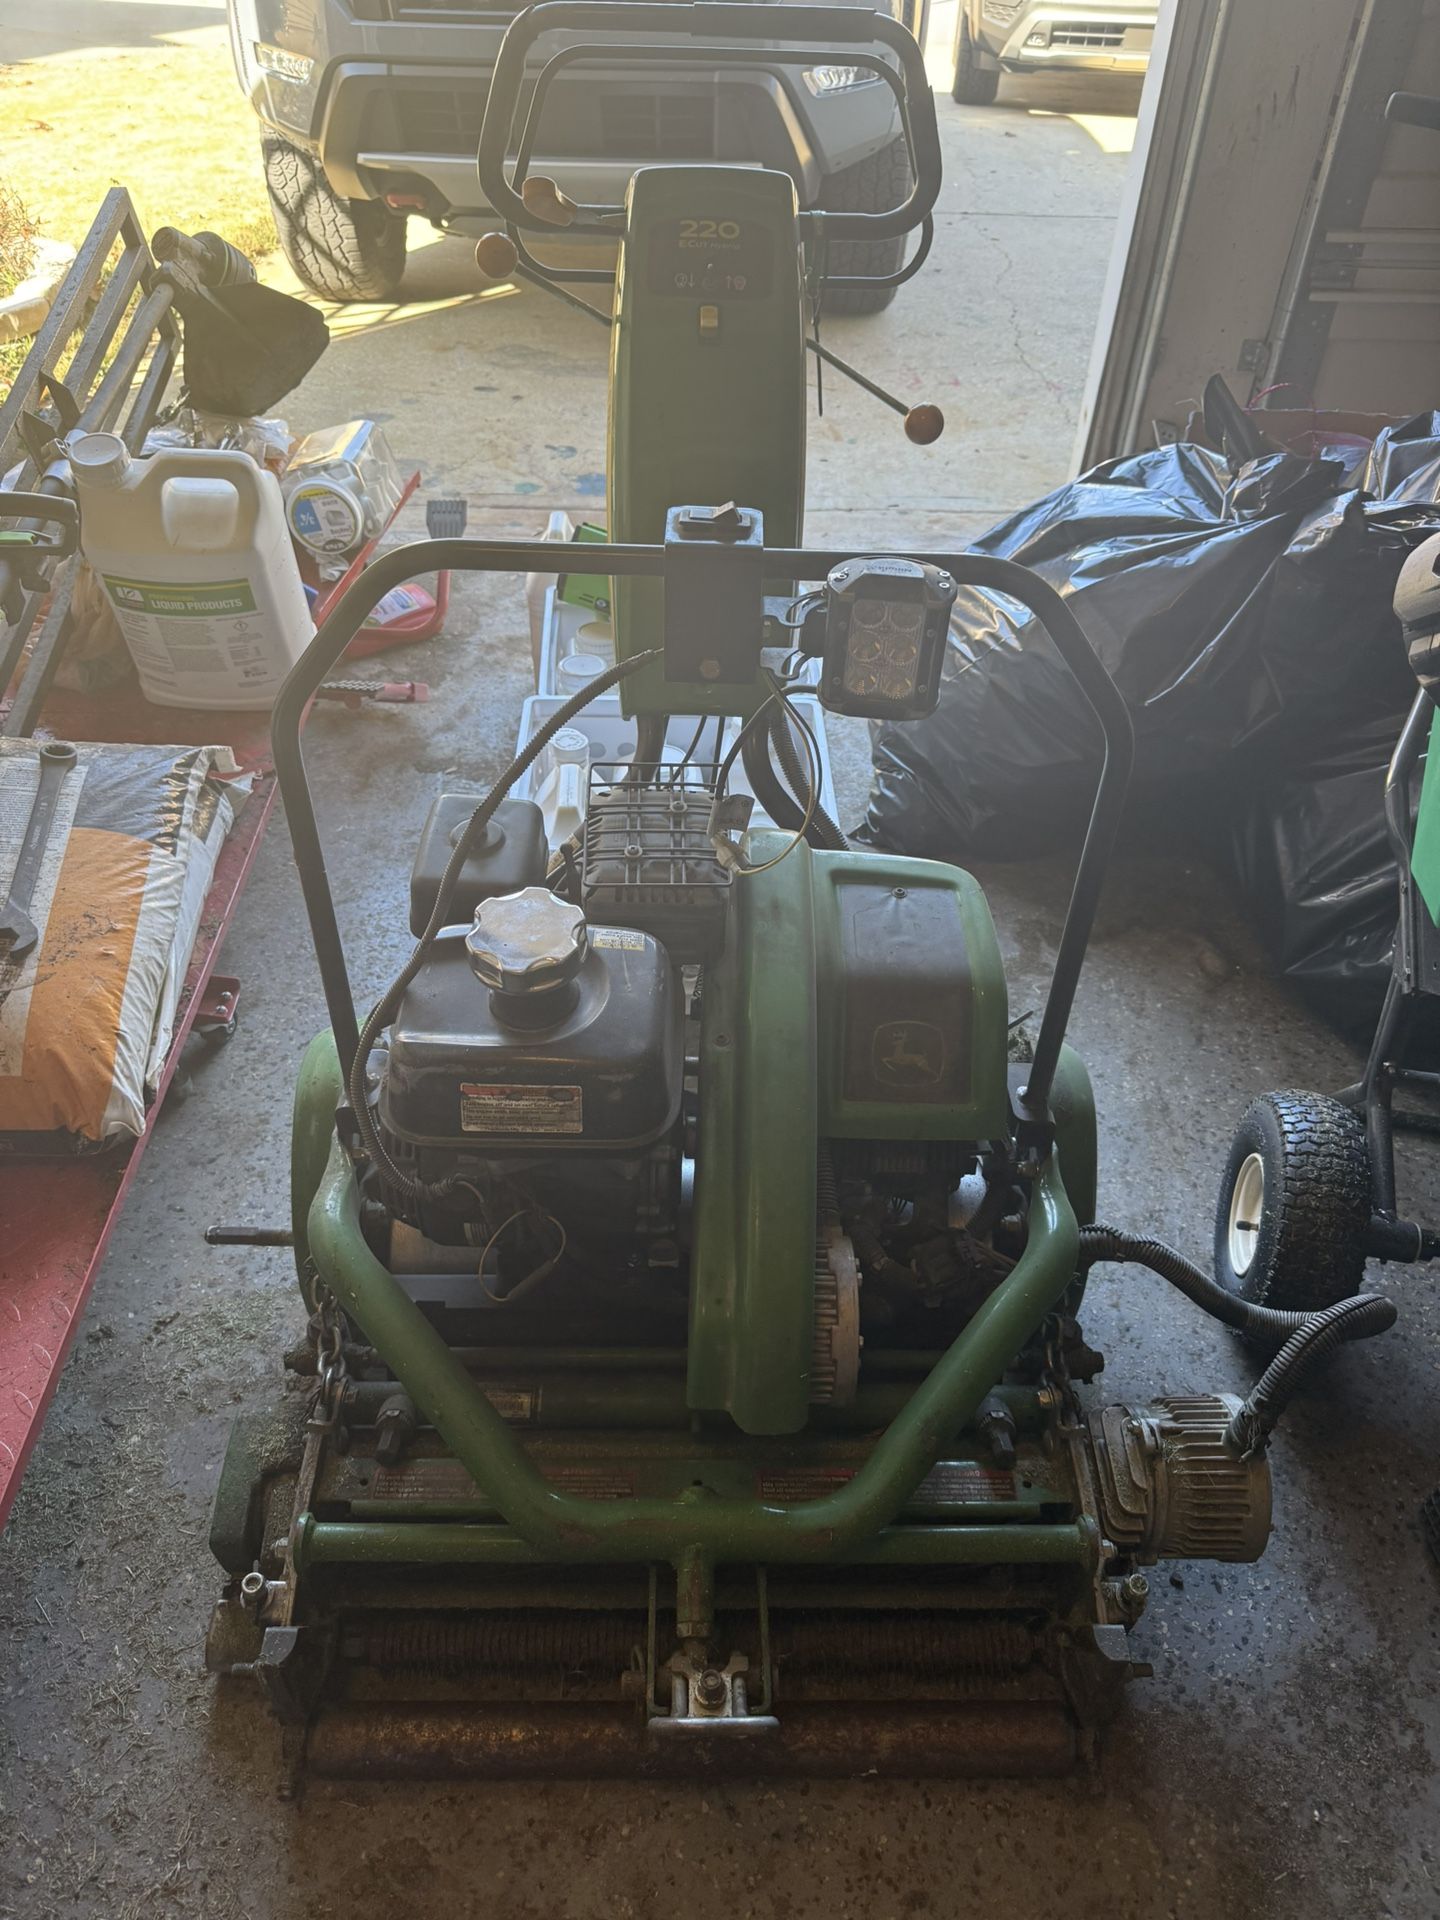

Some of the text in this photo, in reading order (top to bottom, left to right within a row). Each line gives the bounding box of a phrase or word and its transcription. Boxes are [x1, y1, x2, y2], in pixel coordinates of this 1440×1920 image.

[680, 220, 740, 239] 220
[151, 599, 185, 610] LIQUID
[186, 599, 243, 611] PRODUCTS
